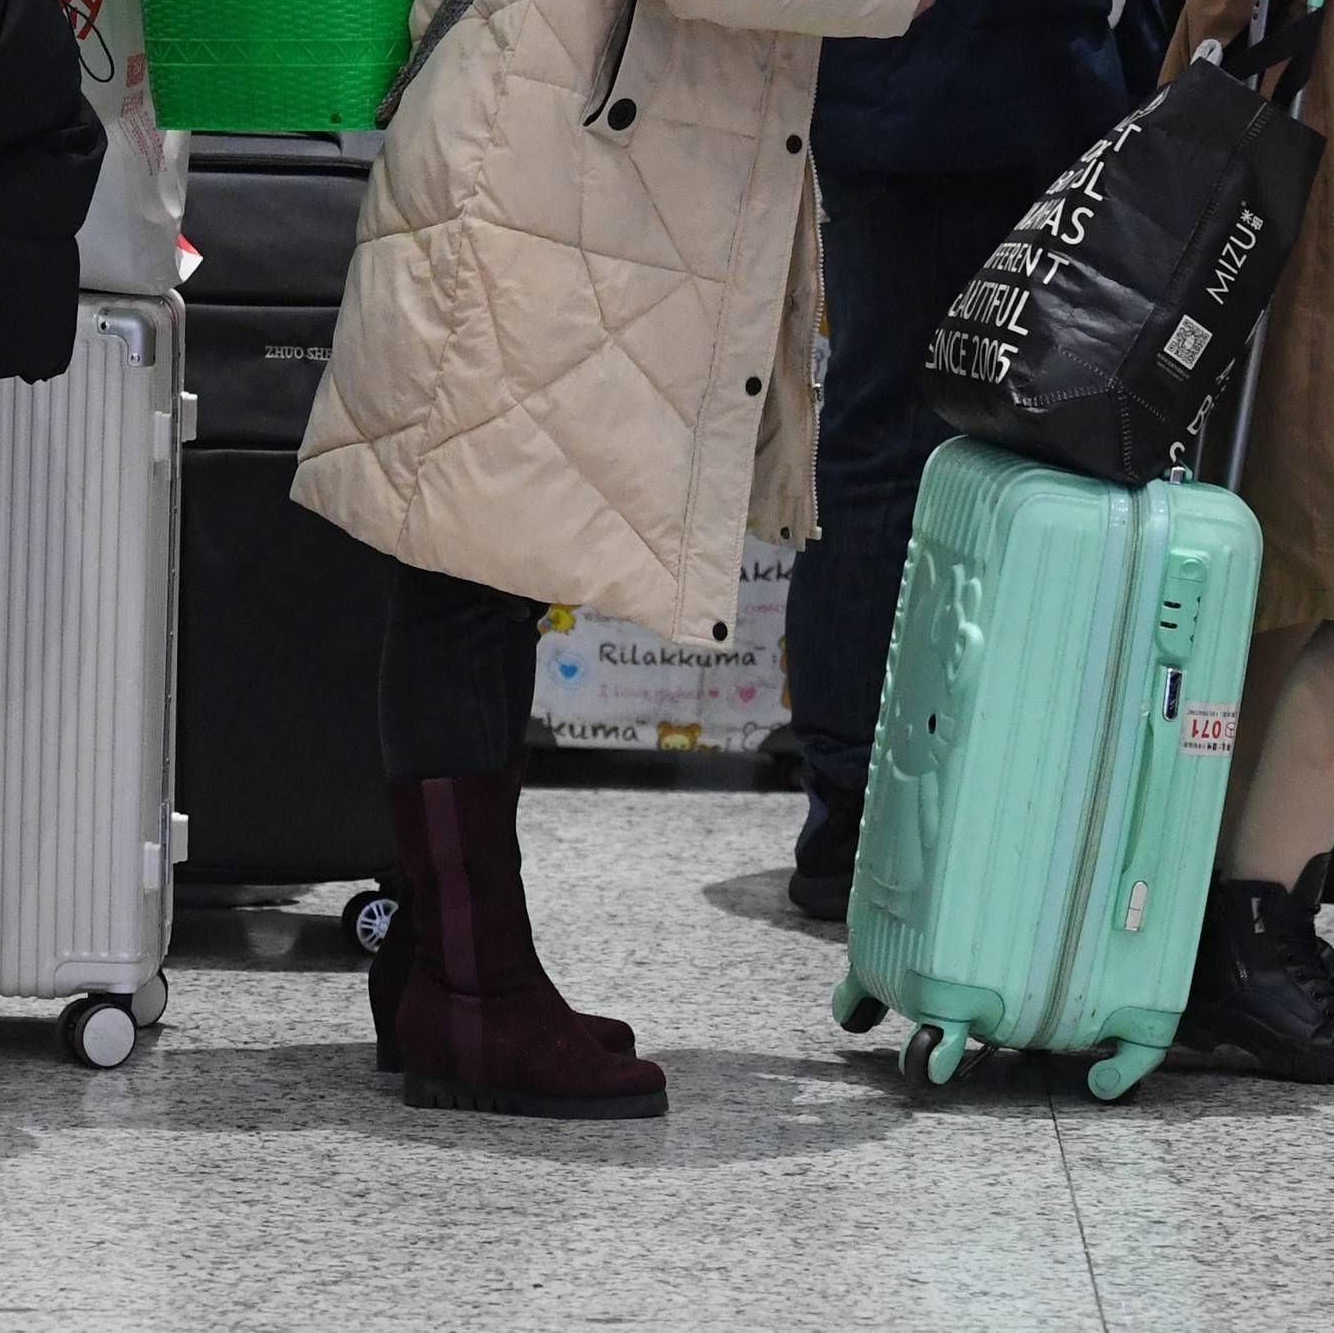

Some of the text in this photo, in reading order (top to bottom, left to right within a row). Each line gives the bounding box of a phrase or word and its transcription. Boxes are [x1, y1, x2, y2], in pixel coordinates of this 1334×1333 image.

[1206, 222, 1258, 306] MIZU
[265, 345, 305, 360] ZHUO
[971, 334, 1020, 384] 2005
[598, 643, 759, 668] Rilakkuma
[1190, 718, 1222, 739] 071
